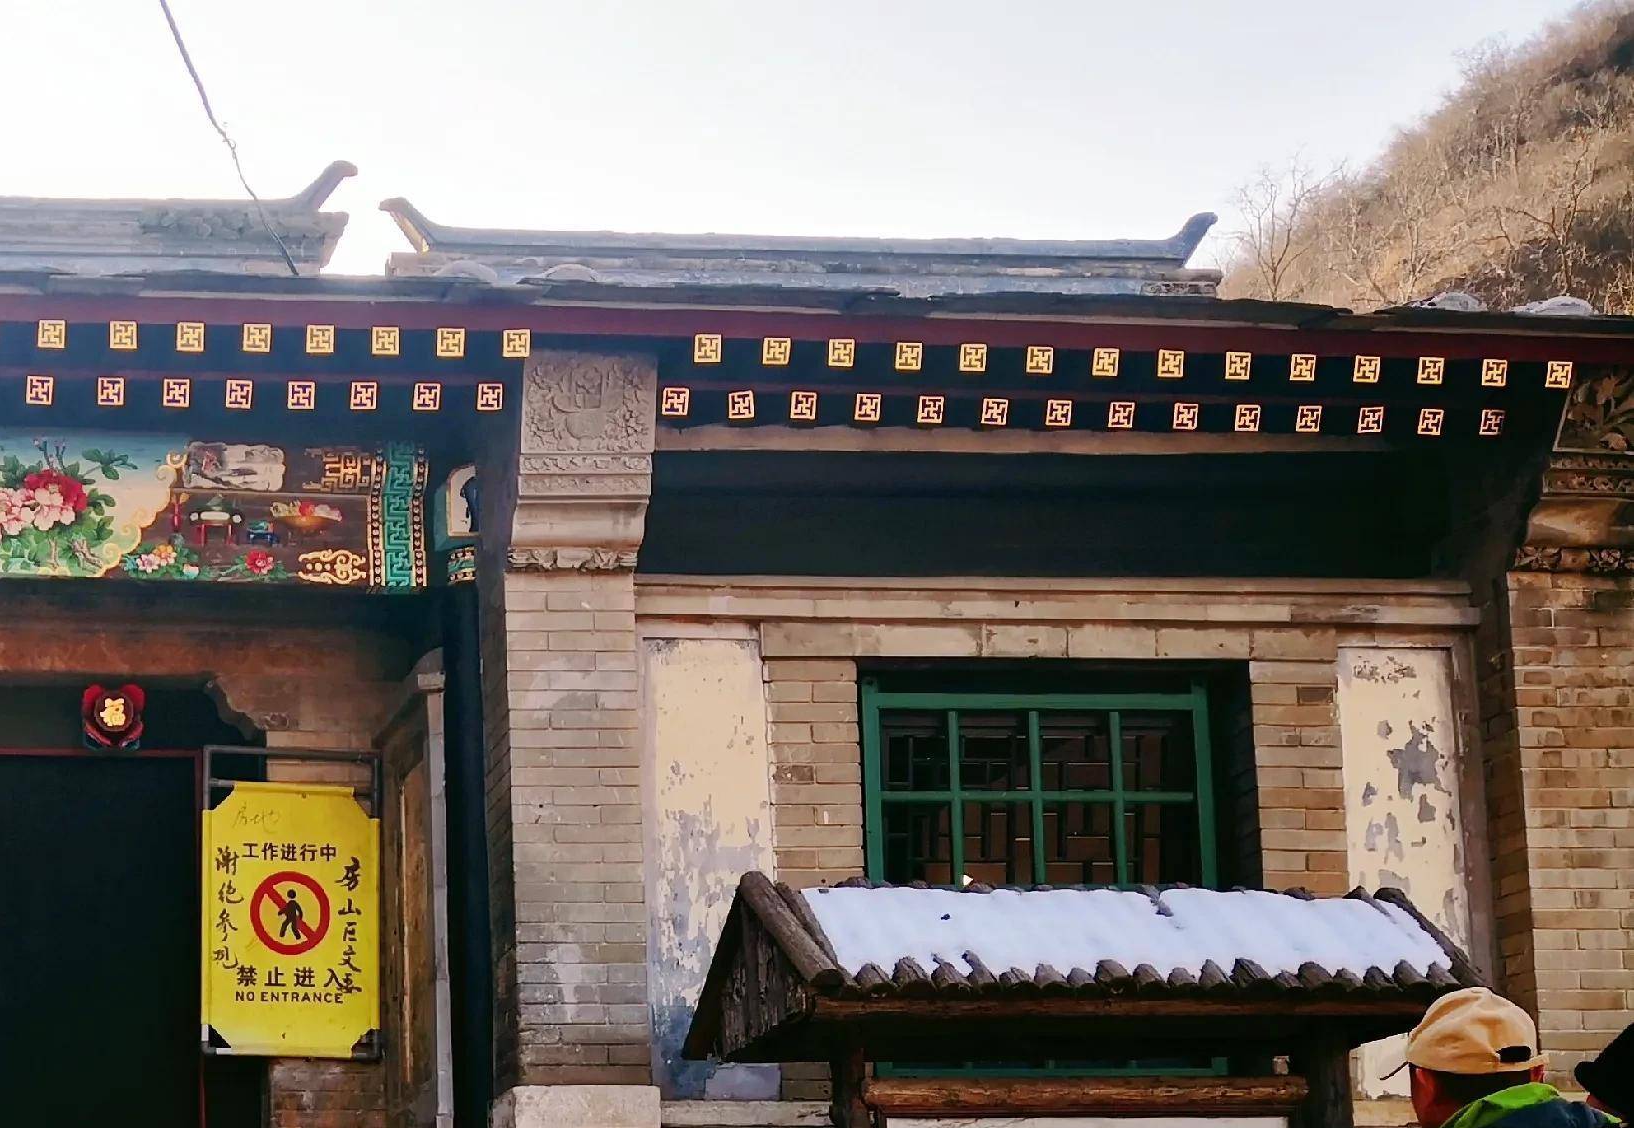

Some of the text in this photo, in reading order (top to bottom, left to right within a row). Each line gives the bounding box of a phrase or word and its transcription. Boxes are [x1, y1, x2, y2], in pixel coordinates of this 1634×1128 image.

[242, 842, 337, 862] 工作进行中
[236, 965, 344, 988] 禁止进入
[235, 991, 344, 1004] NO ENTRANCE
